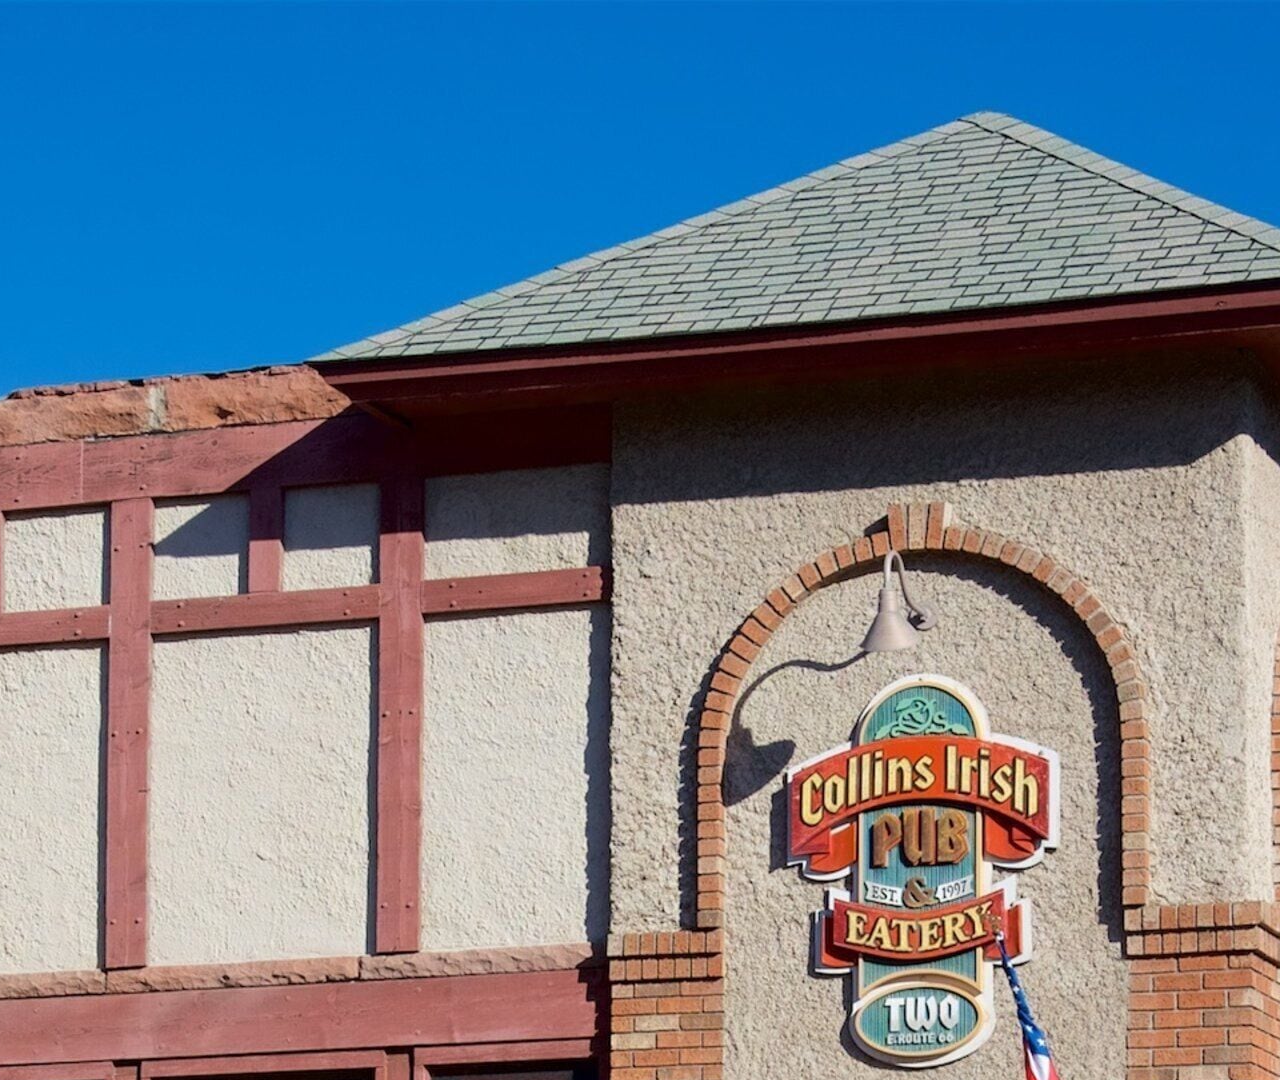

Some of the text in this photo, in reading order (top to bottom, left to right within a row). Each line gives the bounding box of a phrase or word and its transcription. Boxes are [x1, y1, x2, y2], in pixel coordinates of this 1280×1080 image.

[800, 744, 1039, 827] Collins Irish
[872, 805, 969, 868] PUB
[871, 876, 968, 909] EST. & 1997
[845, 900, 993, 952] EATERY
[885, 995, 960, 1033] TWO
[938, 1032, 955, 1044] 66
